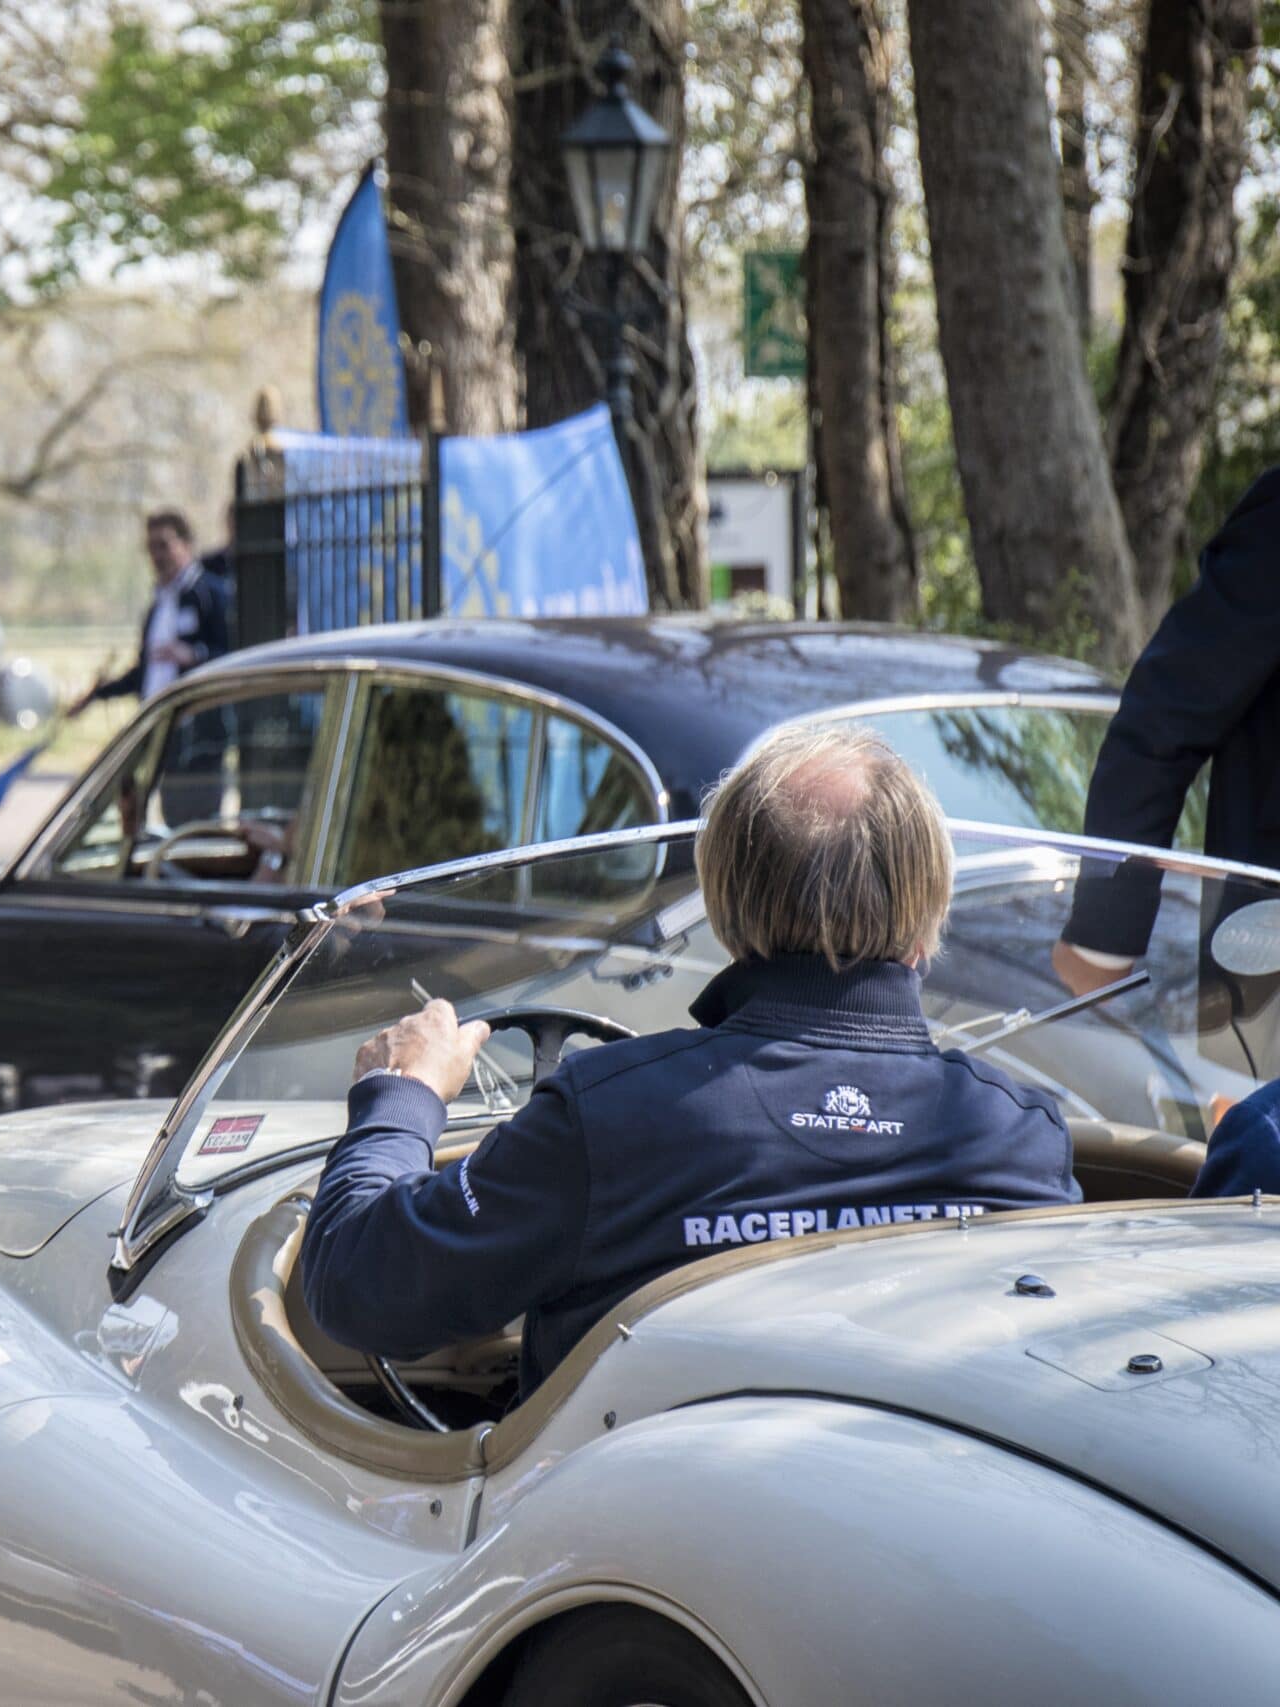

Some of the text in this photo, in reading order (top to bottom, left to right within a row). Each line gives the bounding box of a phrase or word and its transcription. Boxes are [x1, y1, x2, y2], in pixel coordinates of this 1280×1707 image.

[791, 1113, 904, 1134] STATE OF ART
[683, 1205, 984, 1246] RACEPLANET
